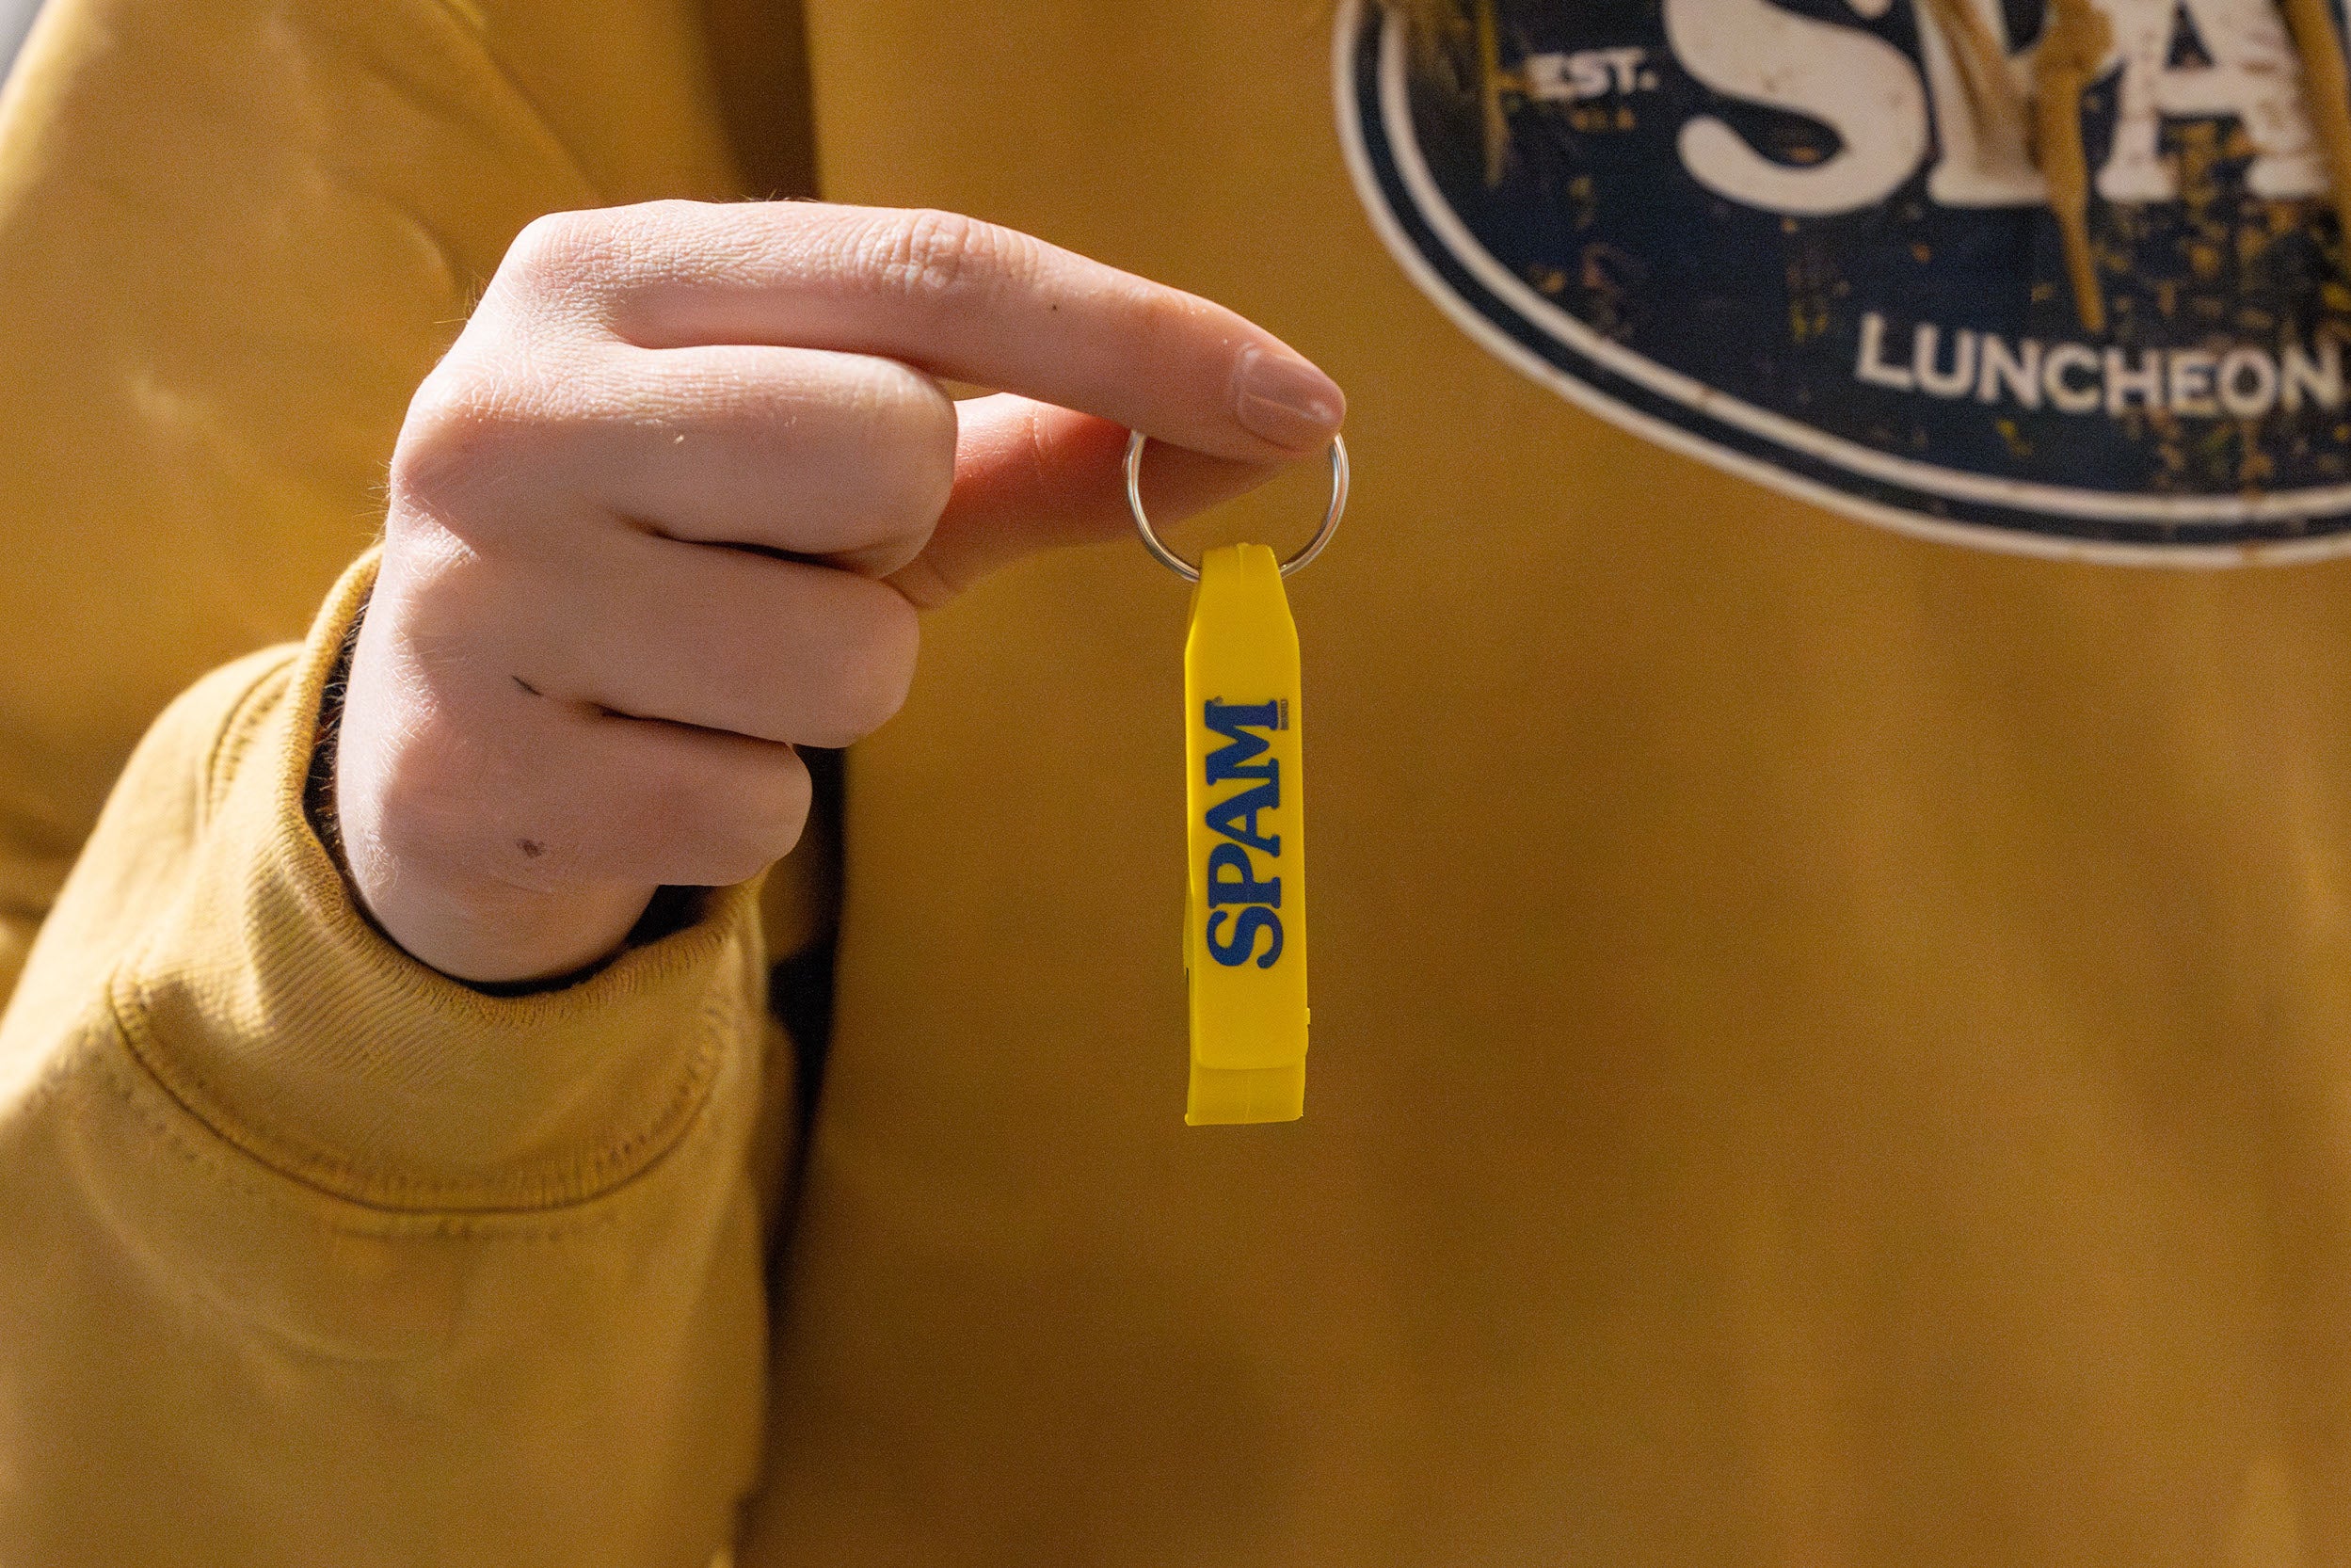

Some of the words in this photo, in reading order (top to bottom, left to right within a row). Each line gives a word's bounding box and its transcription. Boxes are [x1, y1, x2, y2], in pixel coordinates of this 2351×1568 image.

[1523, 47, 1659, 100] EST.
[1857, 311, 2349, 418] LUNCHEON
[1204, 698, 1284, 969] SPAM
